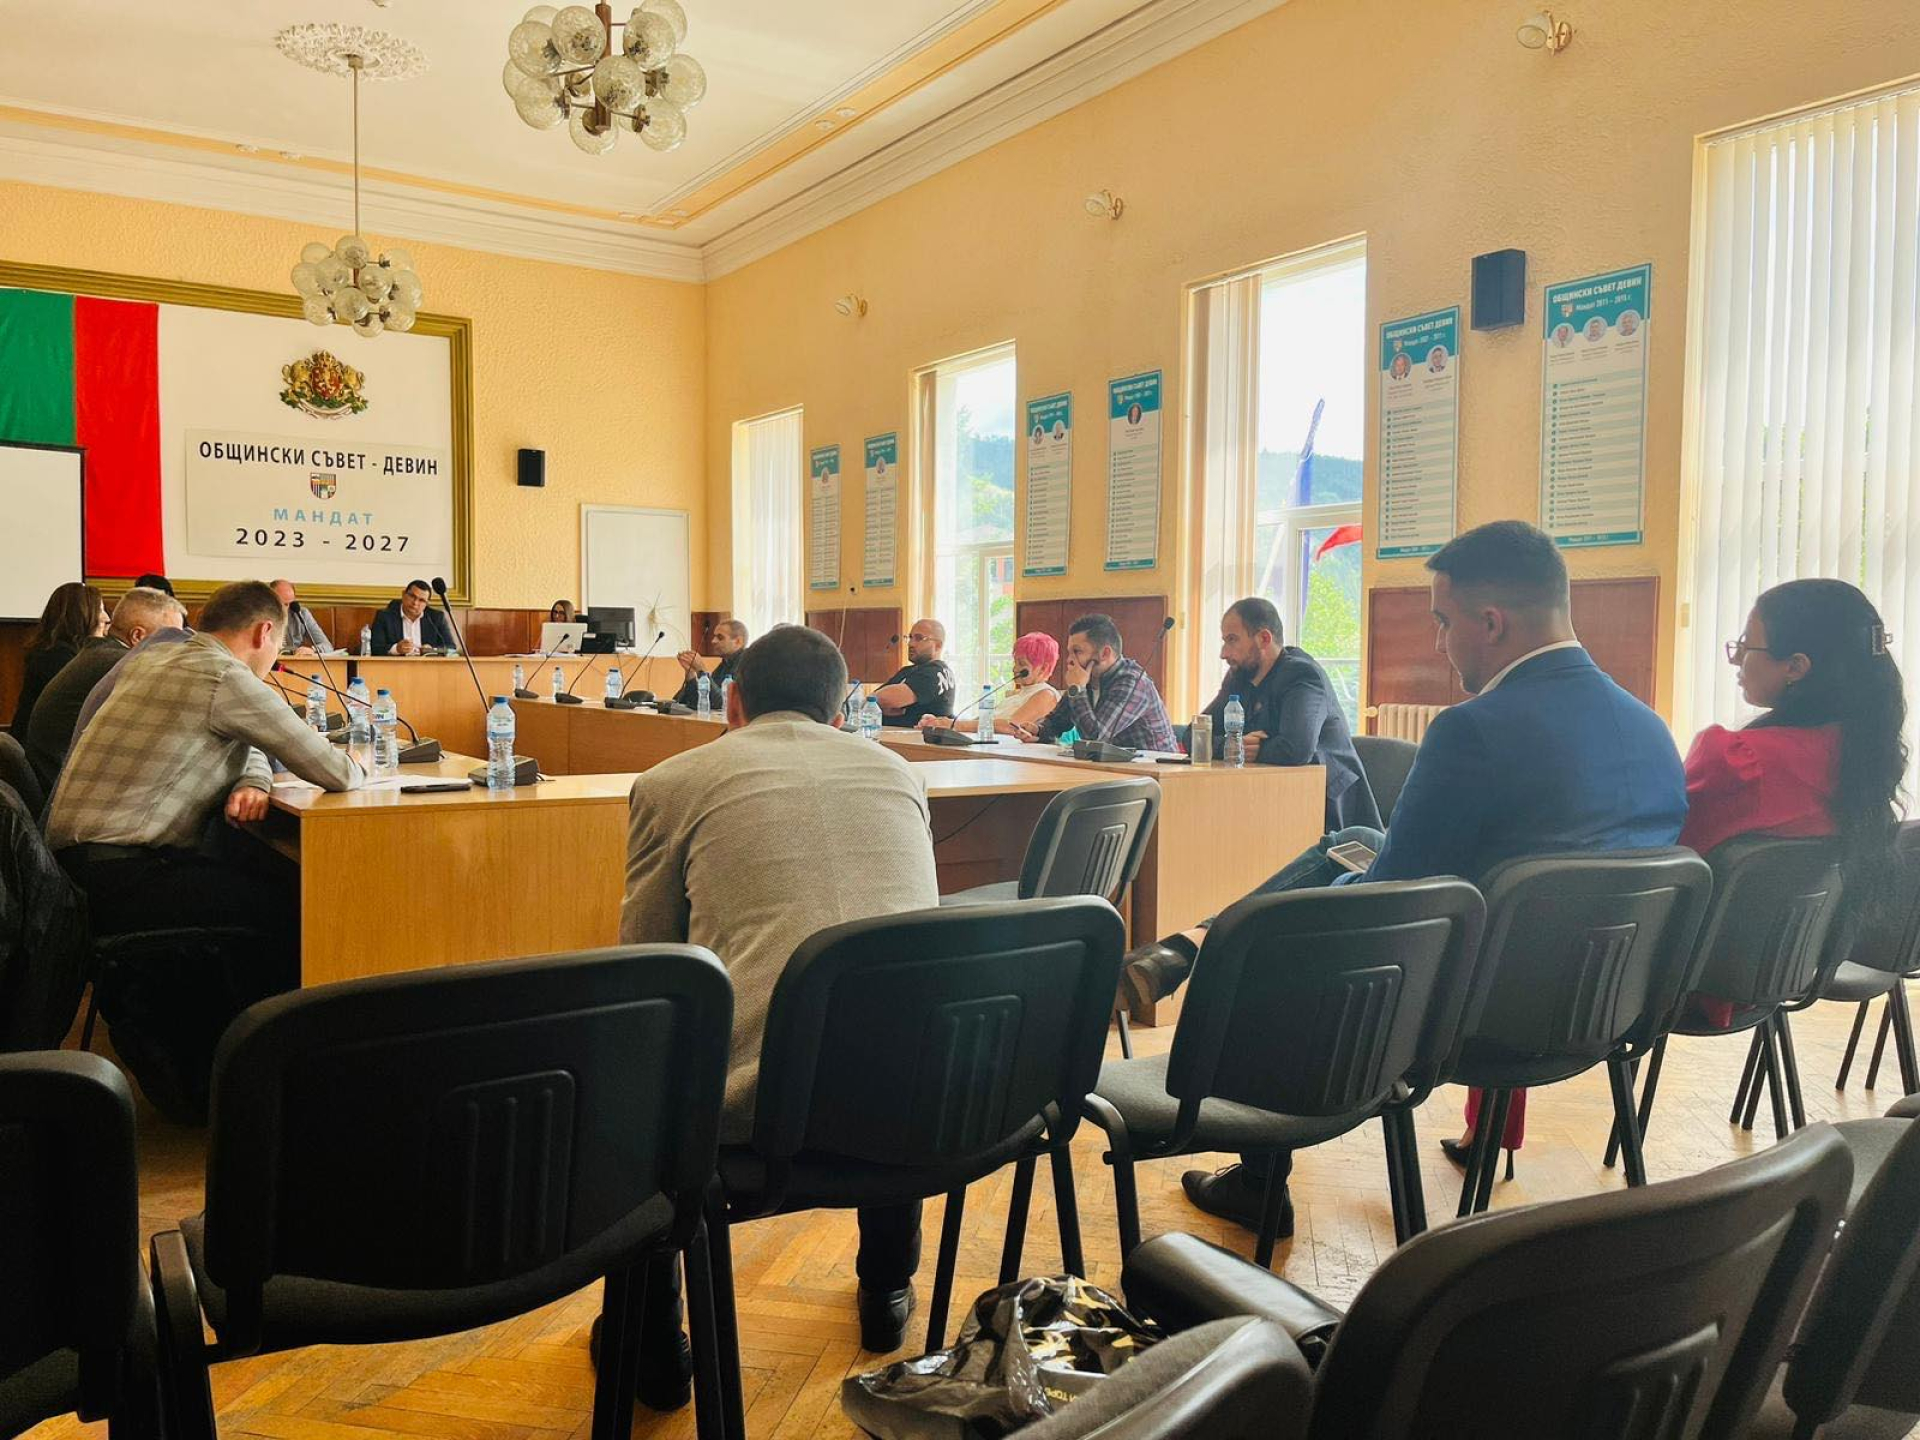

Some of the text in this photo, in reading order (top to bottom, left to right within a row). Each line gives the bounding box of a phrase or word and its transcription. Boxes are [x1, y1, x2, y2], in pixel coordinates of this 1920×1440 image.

[1553, 276, 1643, 303] ОБЩИНСКИ СЪВЕТ ДЕВИН
[199, 441, 305, 464] ОБЩИНСКИ
[311, 449, 366, 470] СЪВЕТ
[383, 456, 438, 476] ДЕВИН
[273, 508, 373, 527] МАНДАТ
[235, 528, 305, 548] 2023
[345, 534, 409, 552] 2027
